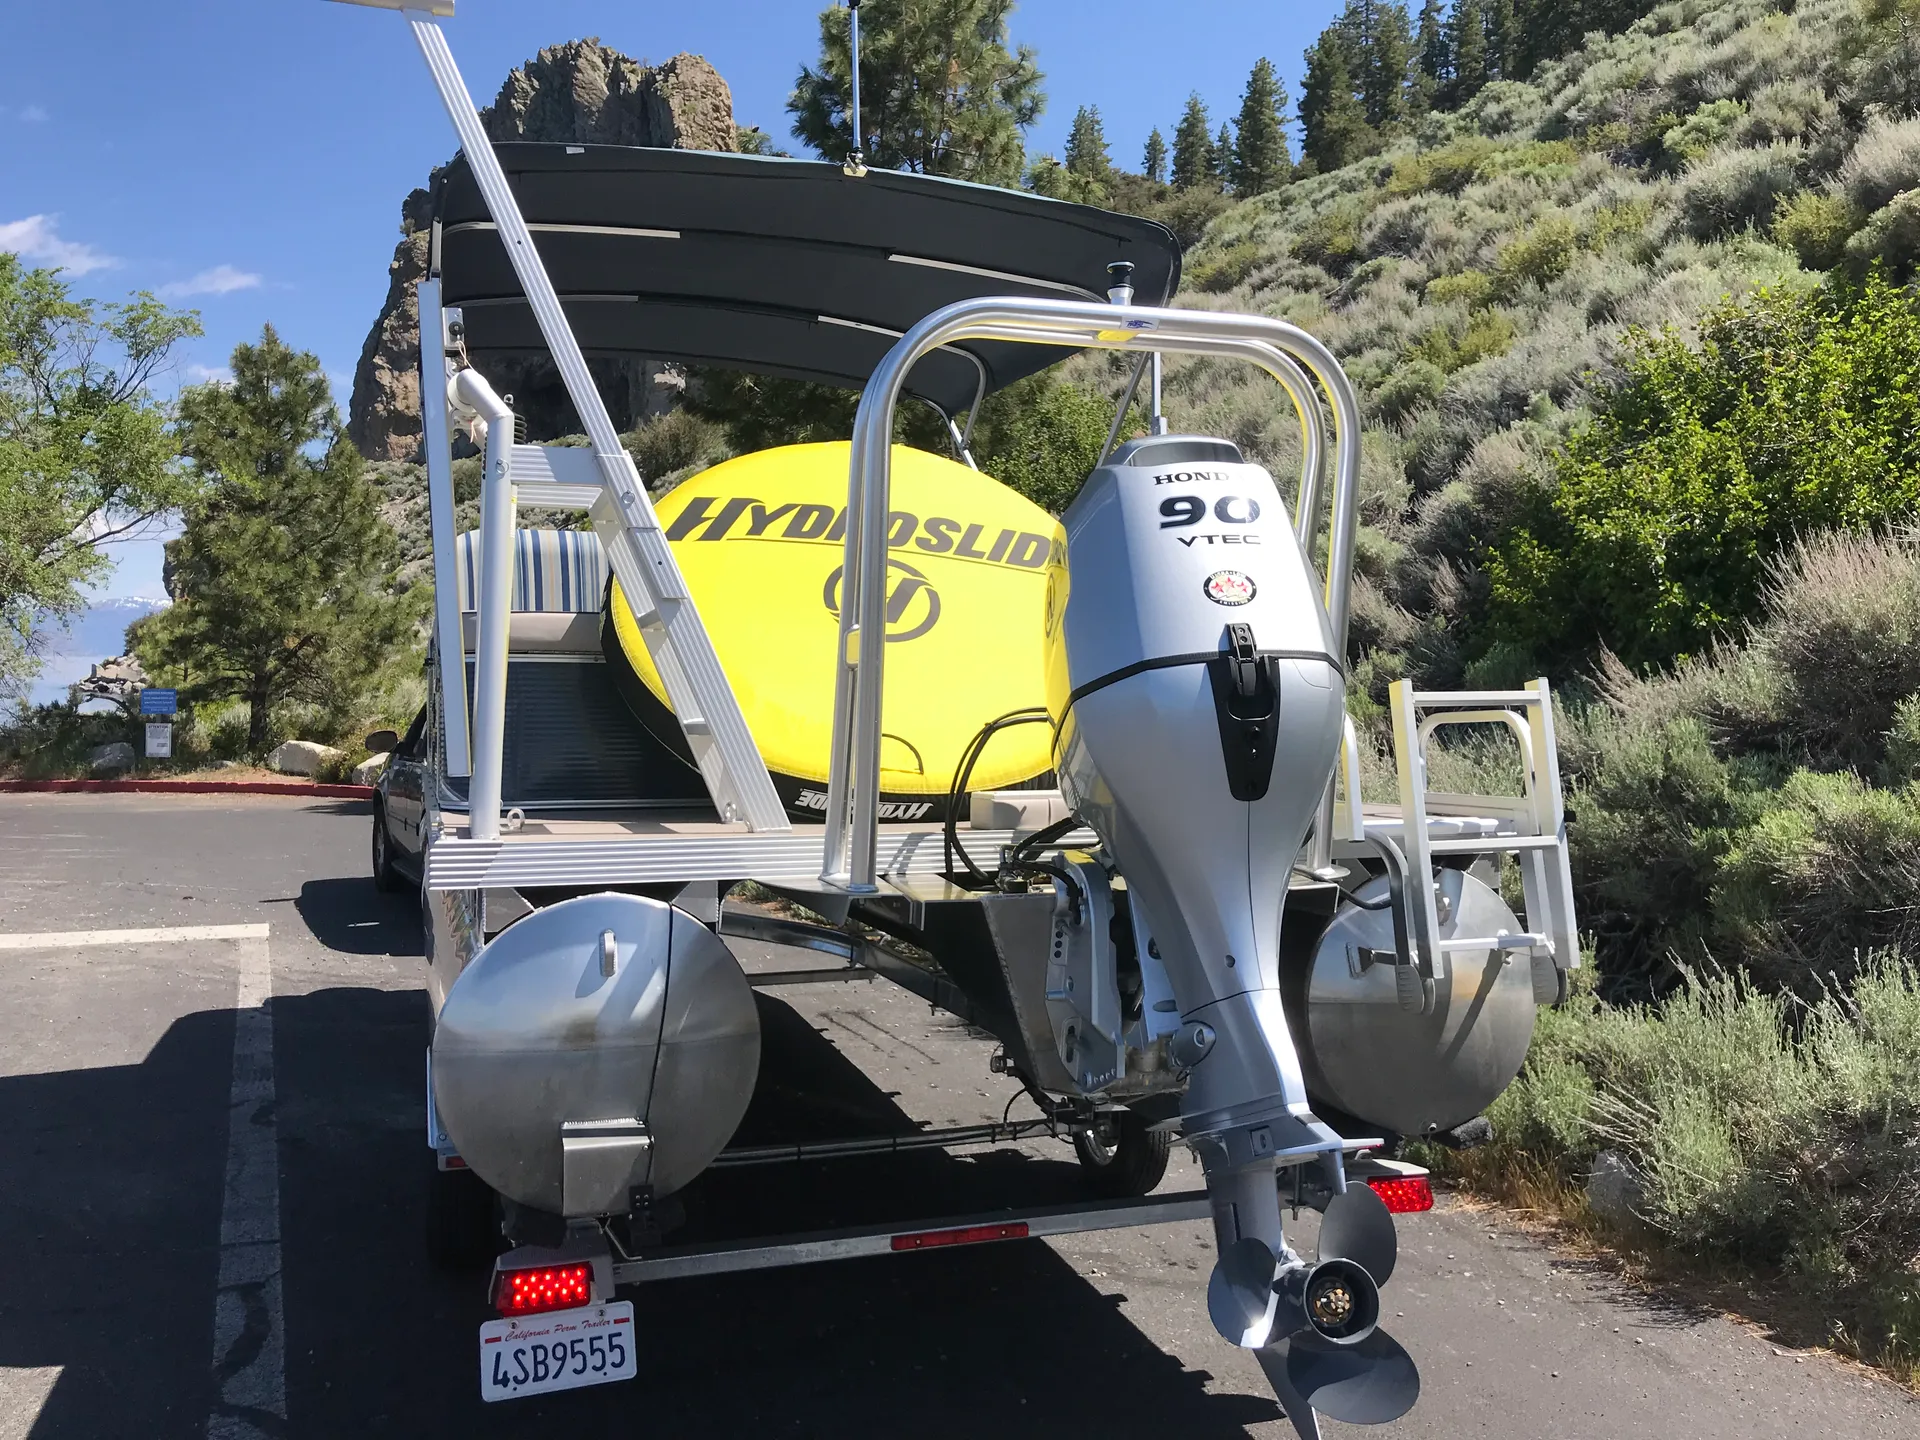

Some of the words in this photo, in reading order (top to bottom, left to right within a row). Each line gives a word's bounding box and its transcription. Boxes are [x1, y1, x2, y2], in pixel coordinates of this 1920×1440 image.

[1153, 471, 1244, 485] HOND
[1158, 495, 1261, 530] 90
[665, 496, 1052, 569] HYDOSLID
[1176, 533, 1262, 547] VTEC
[504, 1328, 550, 1342] California
[554, 1324, 577, 1334] Perm
[581, 1319, 611, 1330] Trailer
[492, 1332, 626, 1388] 4SB9555
